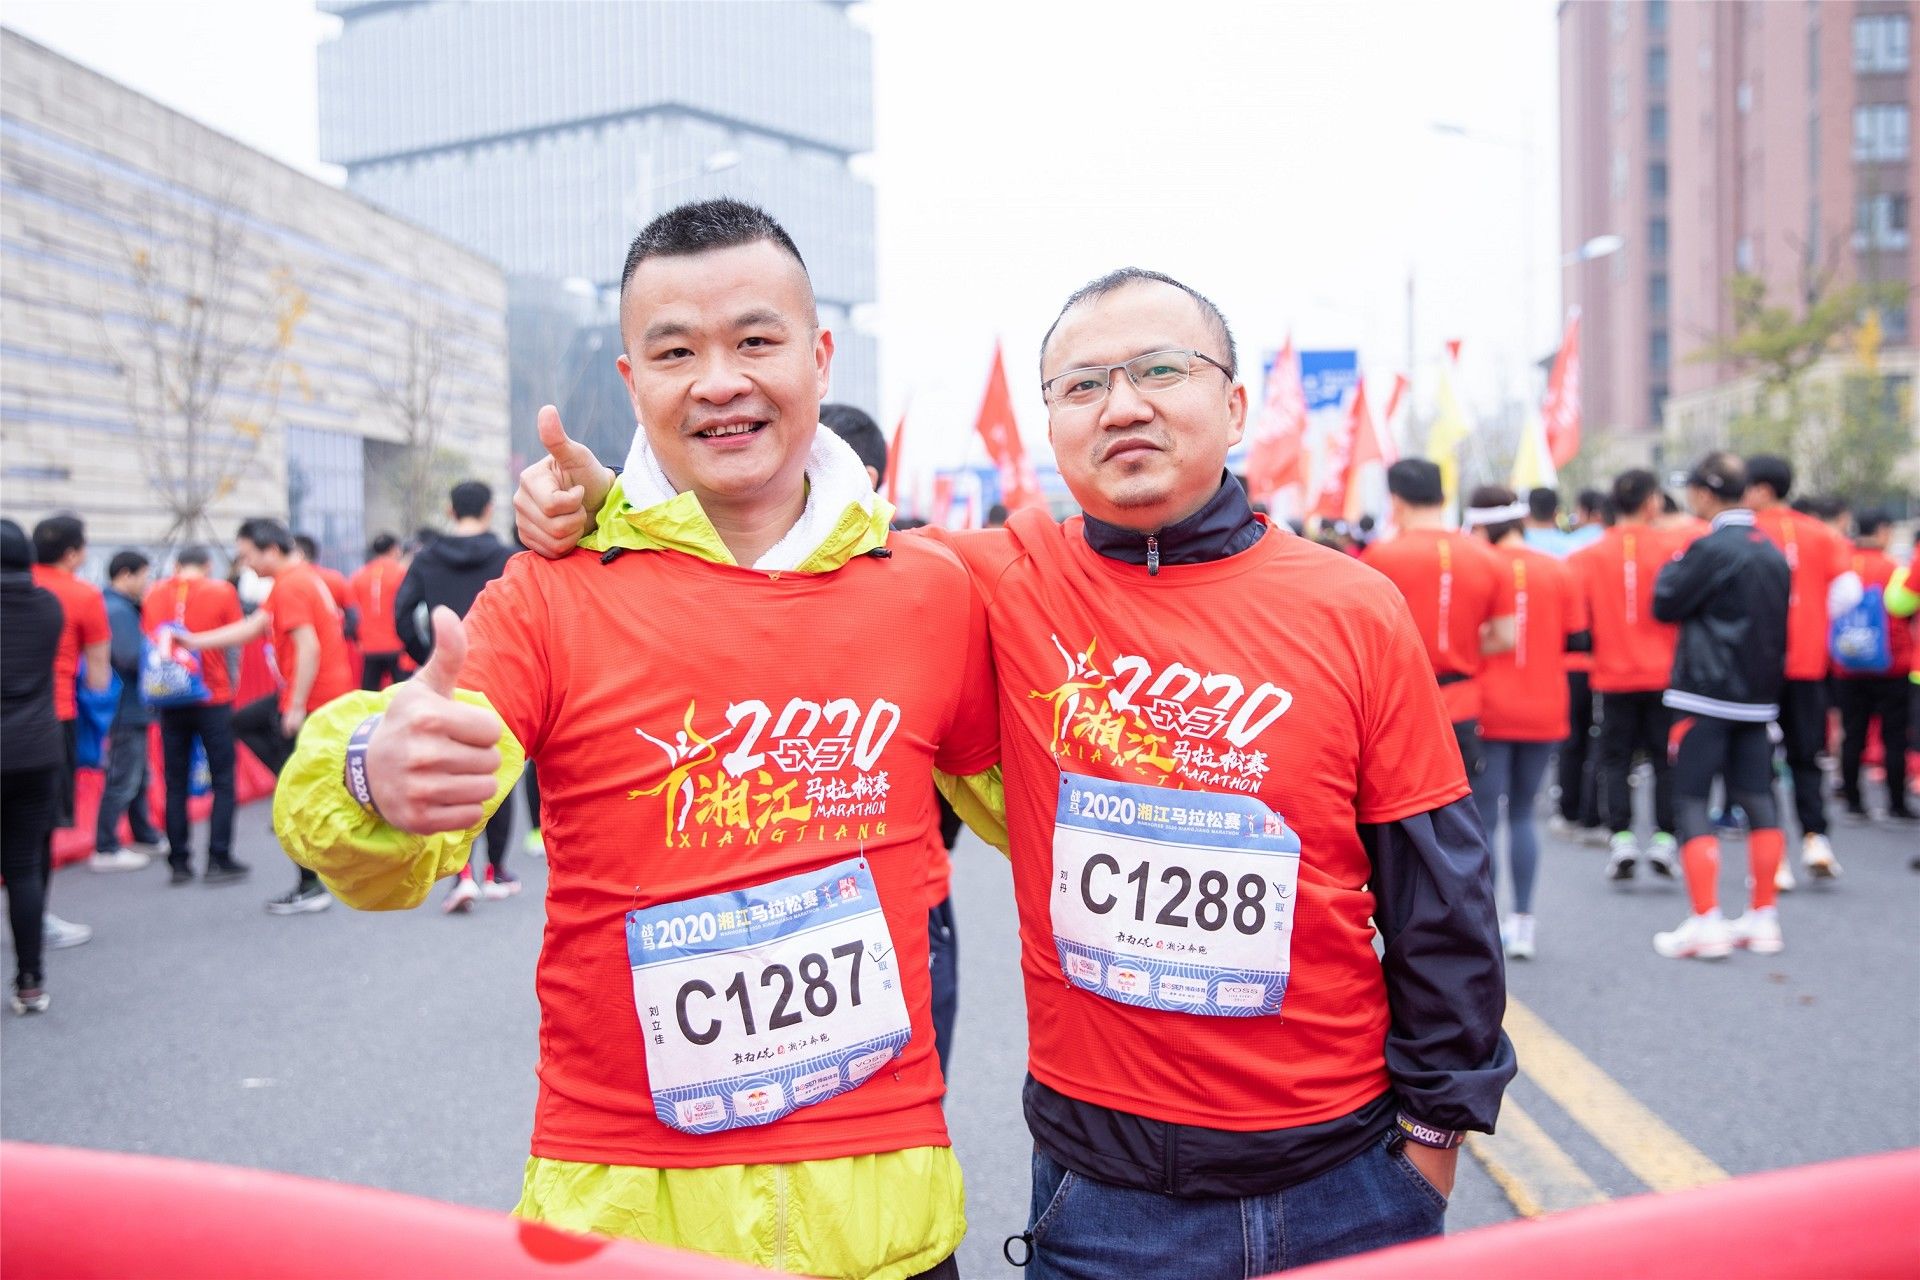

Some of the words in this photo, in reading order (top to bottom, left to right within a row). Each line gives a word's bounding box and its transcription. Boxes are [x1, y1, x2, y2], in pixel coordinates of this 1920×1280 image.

[1108, 653, 1293, 748] 2020
[721, 697, 901, 778] 2020
[1073, 697, 1177, 772] 湘江
[1172, 740, 1270, 780] 马拉松赛
[1176, 765, 1261, 794] MARATHON
[693, 769, 813, 829] 湘江
[805, 770, 891, 801] 马拉松赛
[815, 801, 887, 818] MARATHON
[678, 822, 888, 848] XIANGJIANG
[1080, 853, 1267, 936] C1288
[675, 939, 865, 1046] C1287
[649, 1005, 665, 1045] 刘立佳
[855, 1053, 887, 1068] VOSS
[1413, 1125, 1440, 1143] 2020
